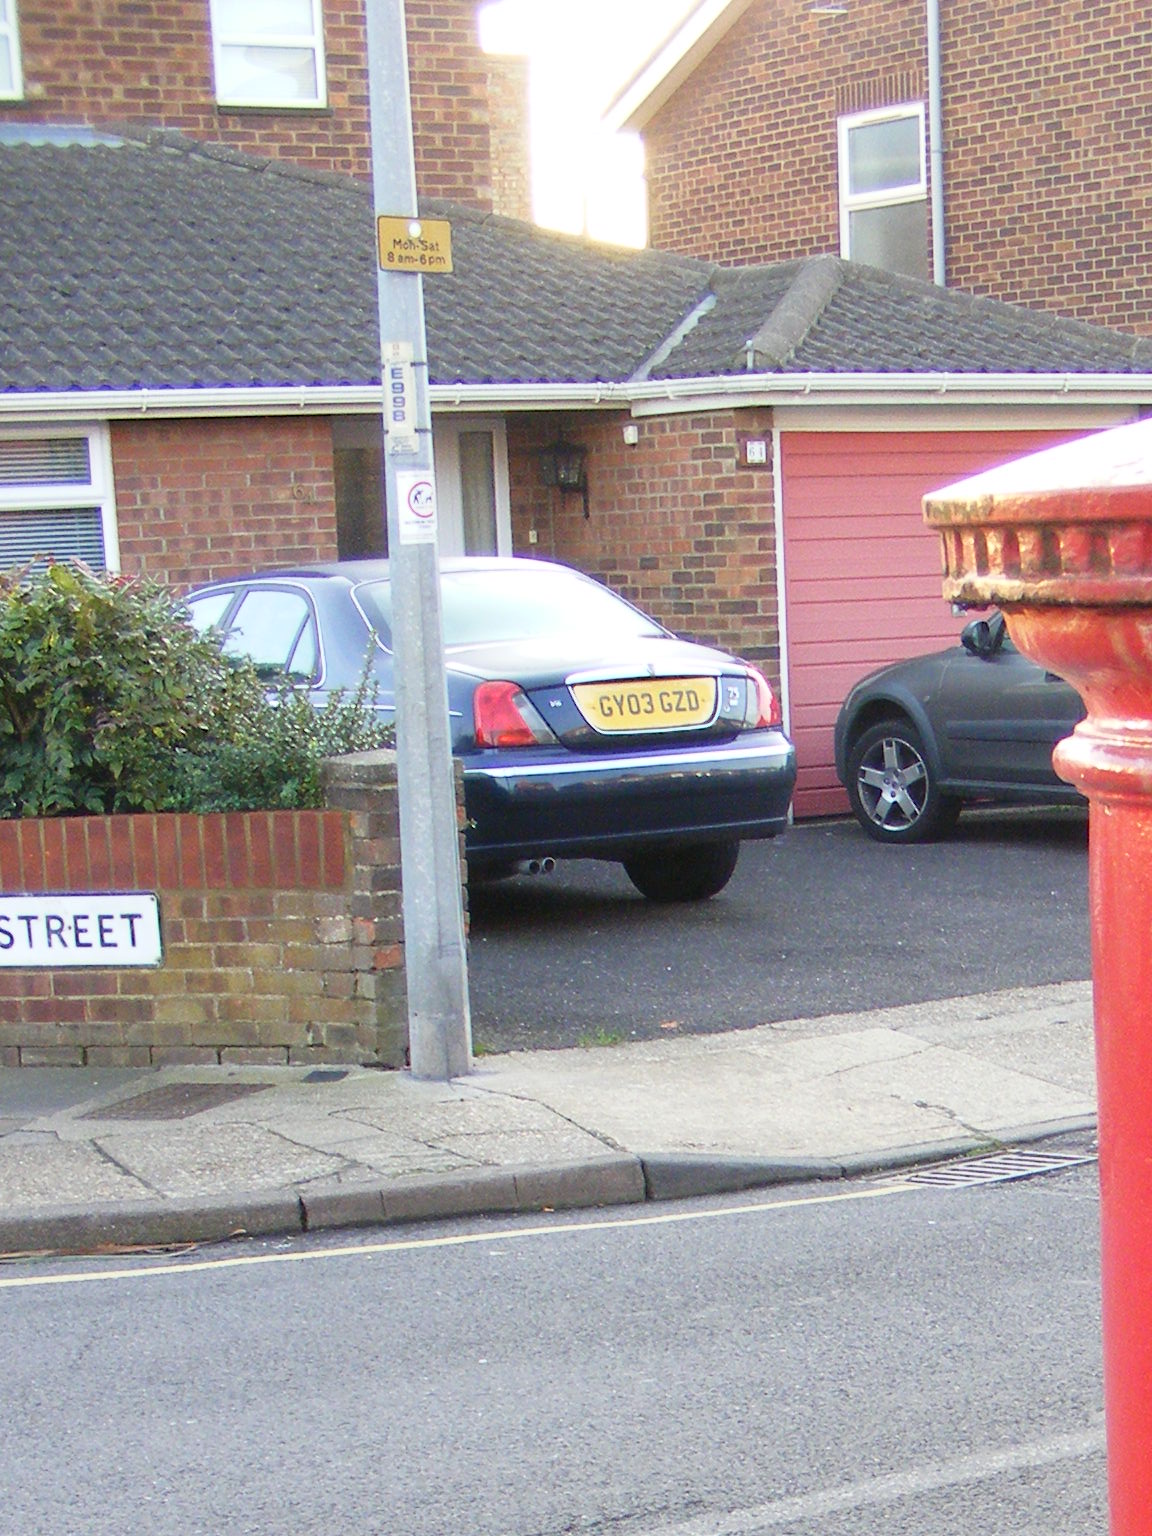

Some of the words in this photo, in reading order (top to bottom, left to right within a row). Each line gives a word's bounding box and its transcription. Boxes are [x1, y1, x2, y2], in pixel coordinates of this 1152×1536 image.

[393, 238, 440, 251] Mon-Sat
[599, 692, 655, 717] GY03
[659, 689, 700, 713] GZD
[0, 914, 142, 949] STREET
